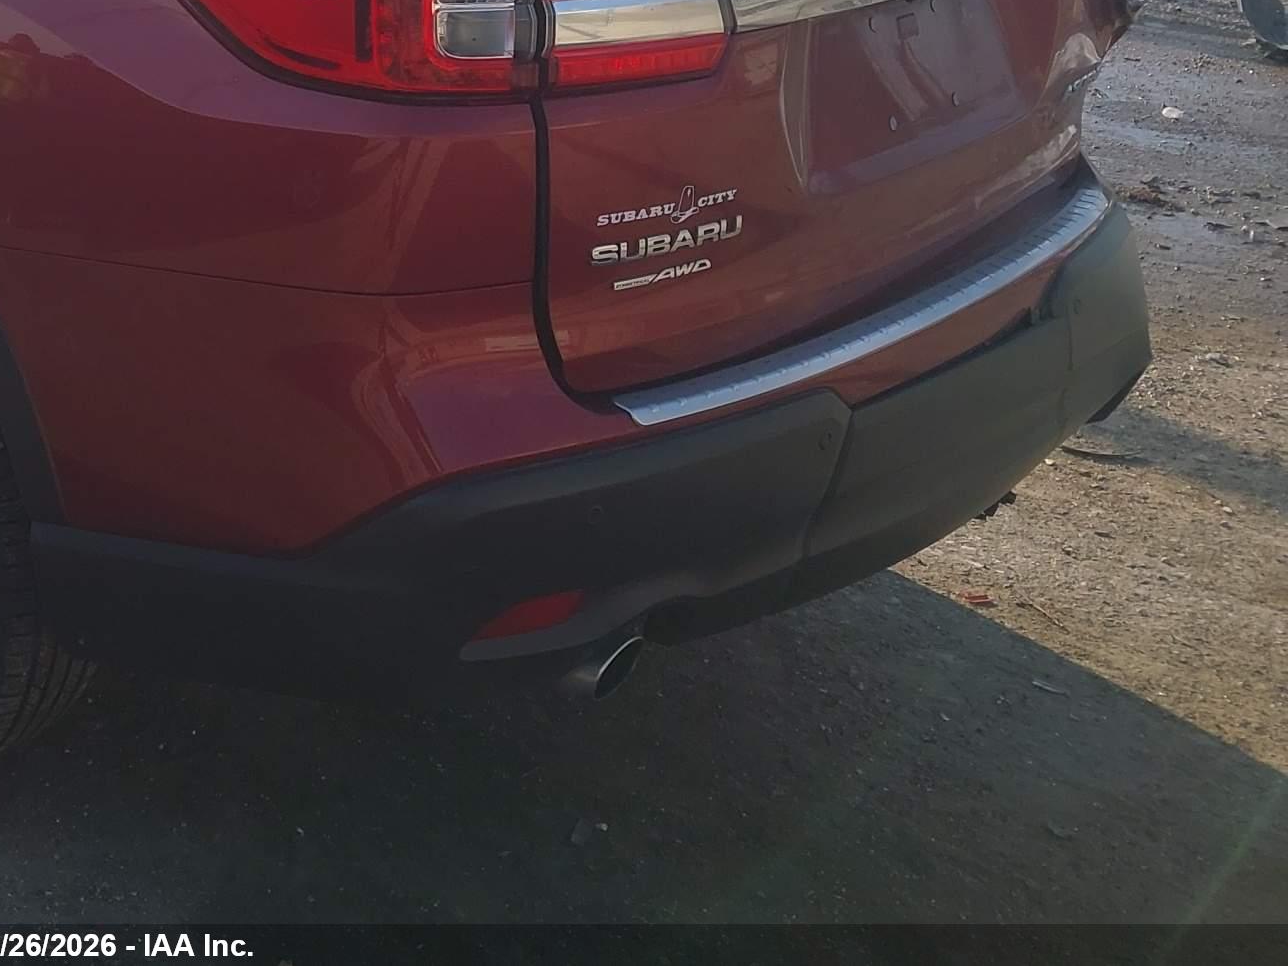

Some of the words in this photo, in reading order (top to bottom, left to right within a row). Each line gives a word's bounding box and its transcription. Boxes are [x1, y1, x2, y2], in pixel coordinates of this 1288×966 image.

[596, 202, 675, 226] SUBARU
[697, 188, 738, 208] CITY
[591, 215, 743, 264] SUBARU
[652, 258, 712, 283] AWD
